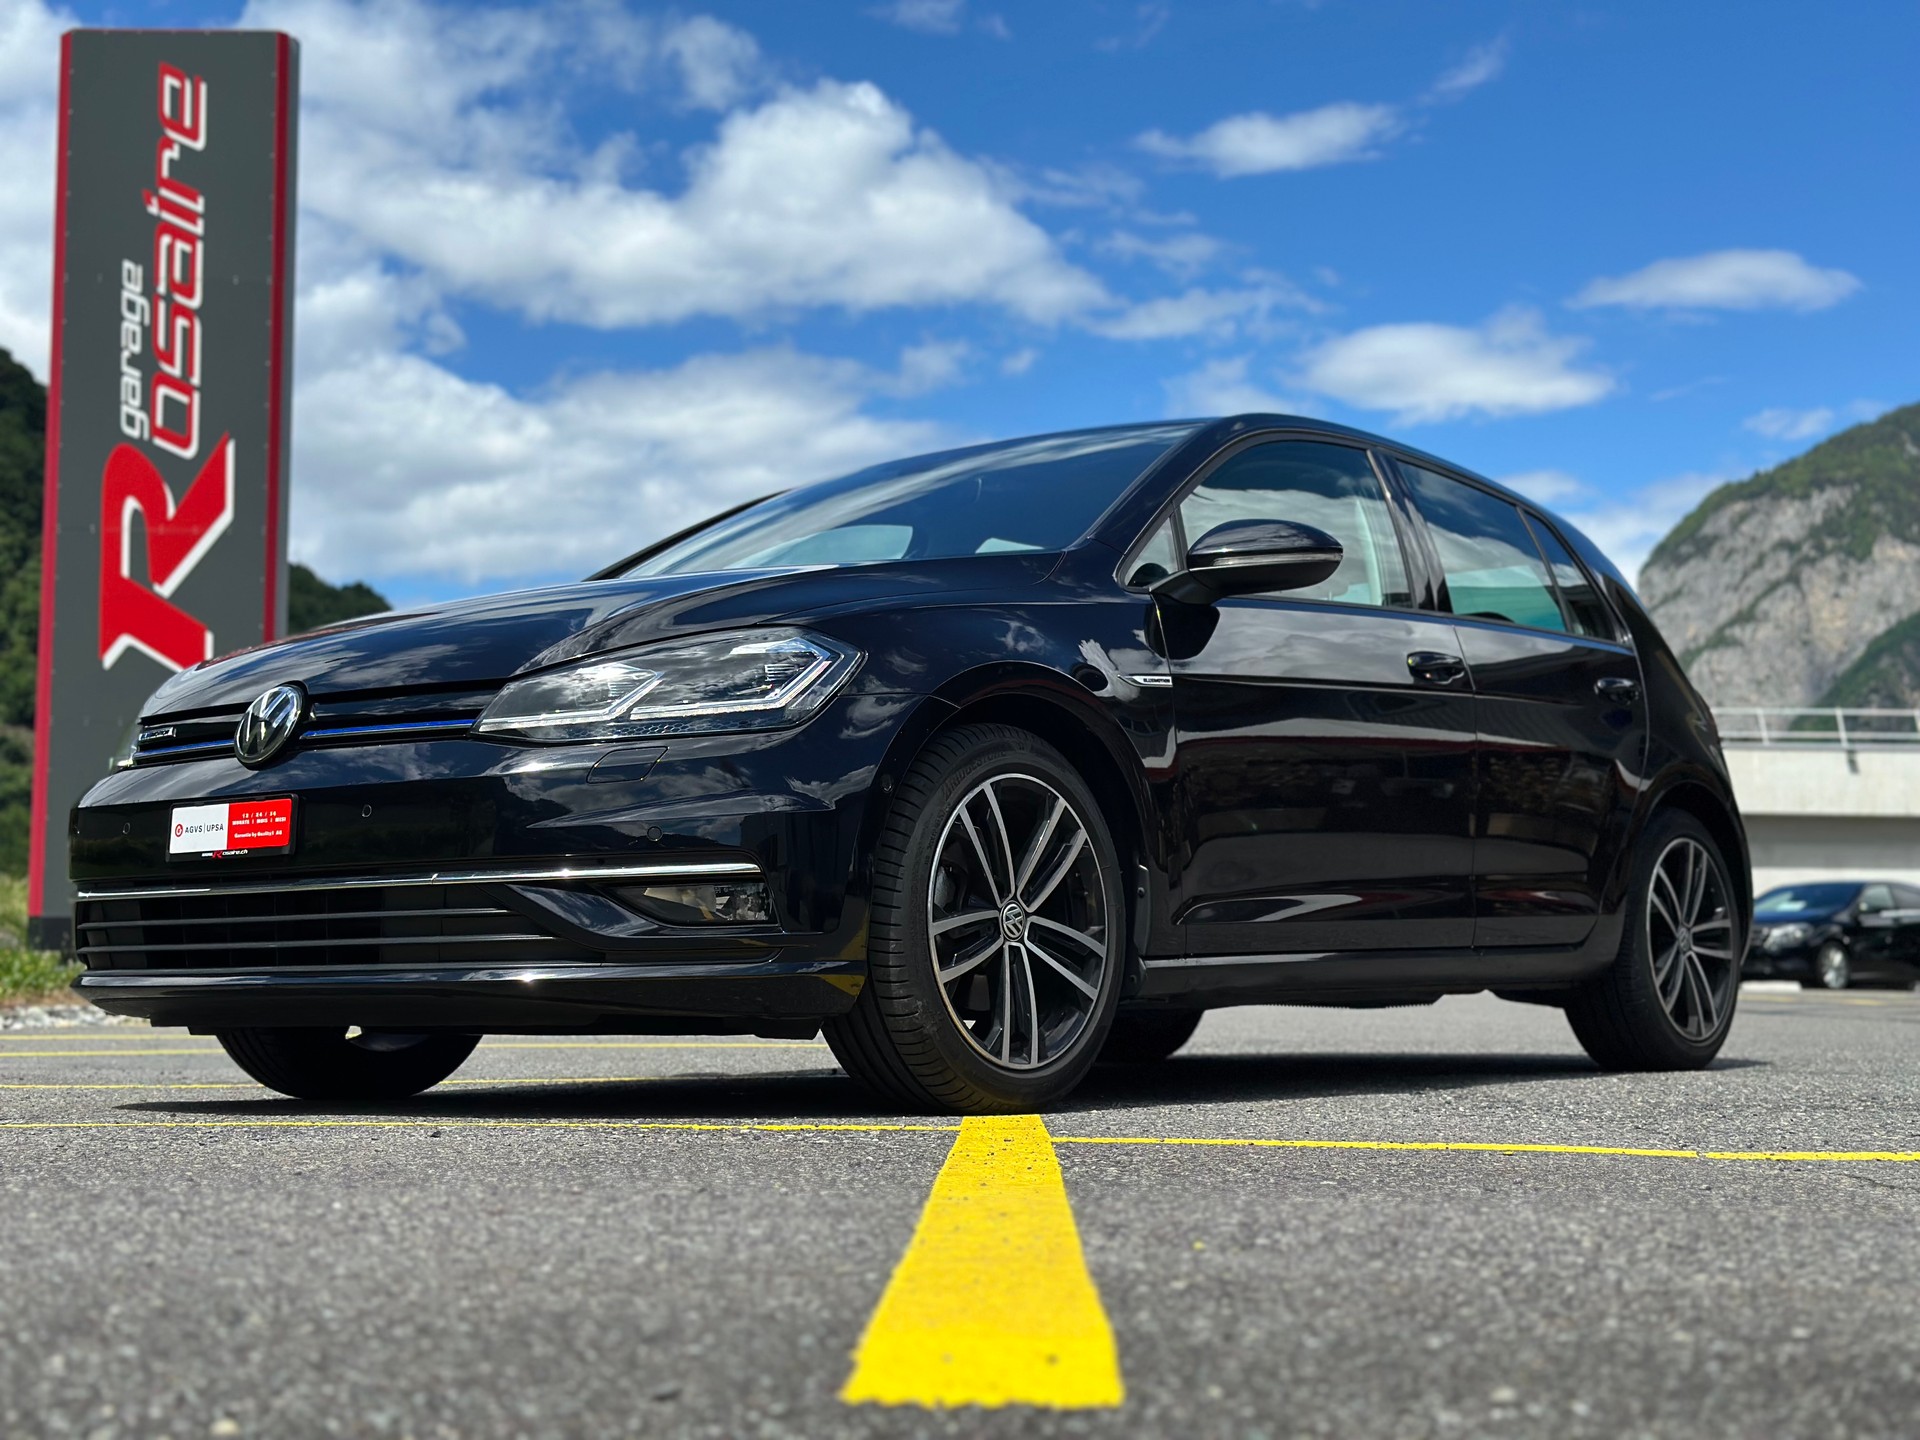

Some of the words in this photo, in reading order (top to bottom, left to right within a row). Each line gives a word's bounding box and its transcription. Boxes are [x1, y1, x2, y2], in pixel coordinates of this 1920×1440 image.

[121, 259, 149, 440] garage
[184, 825, 203, 834] AGVS
[206, 823, 224, 832] UPSA
